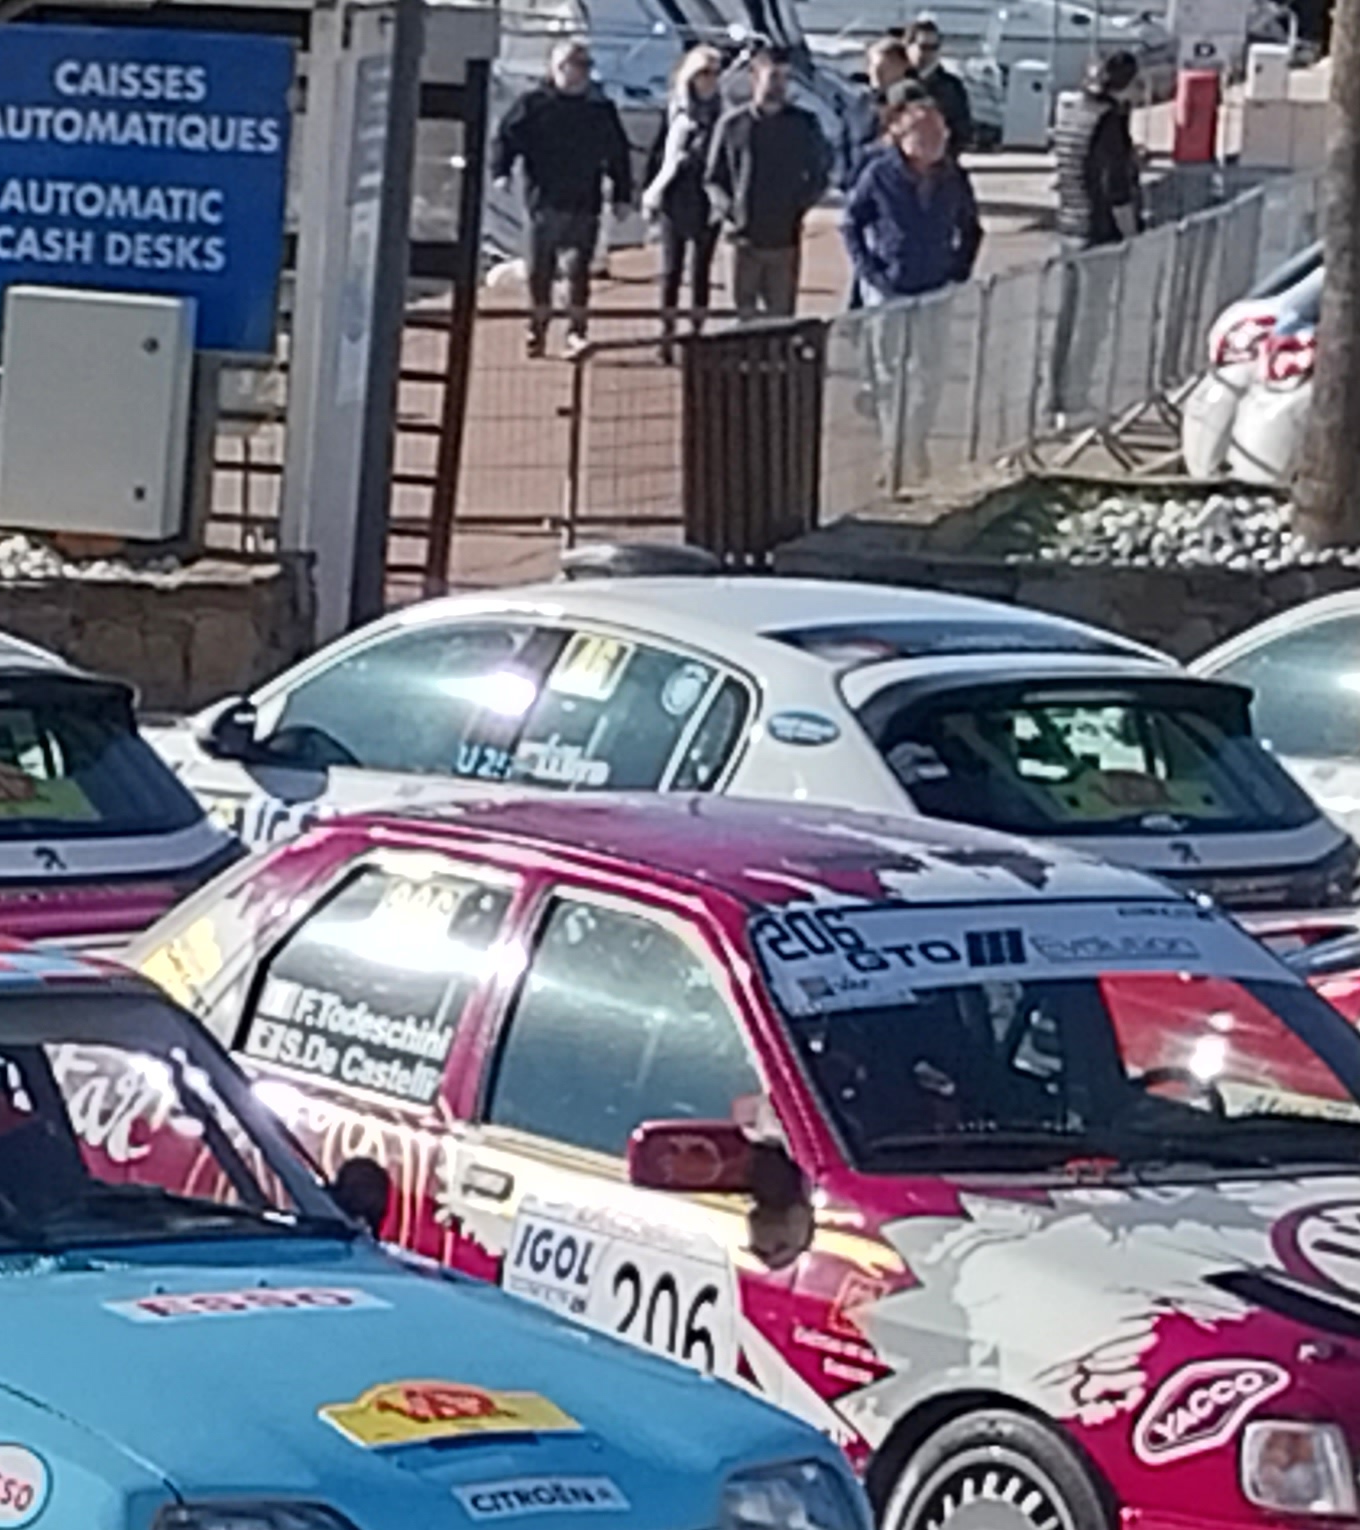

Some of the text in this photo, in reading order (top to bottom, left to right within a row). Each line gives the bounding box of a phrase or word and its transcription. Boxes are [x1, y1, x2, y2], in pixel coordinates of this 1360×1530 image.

[54, 60, 207, 102] CAISSES
[104, 231, 227, 272] DESKS
[766, 908, 864, 963] 206
[340, 1045, 441, 1101] Castelli
[513, 1224, 595, 1286] IGOL
[1152, 1369, 1266, 1446] YACCO
[468, 1481, 598, 1514] CITROËN
